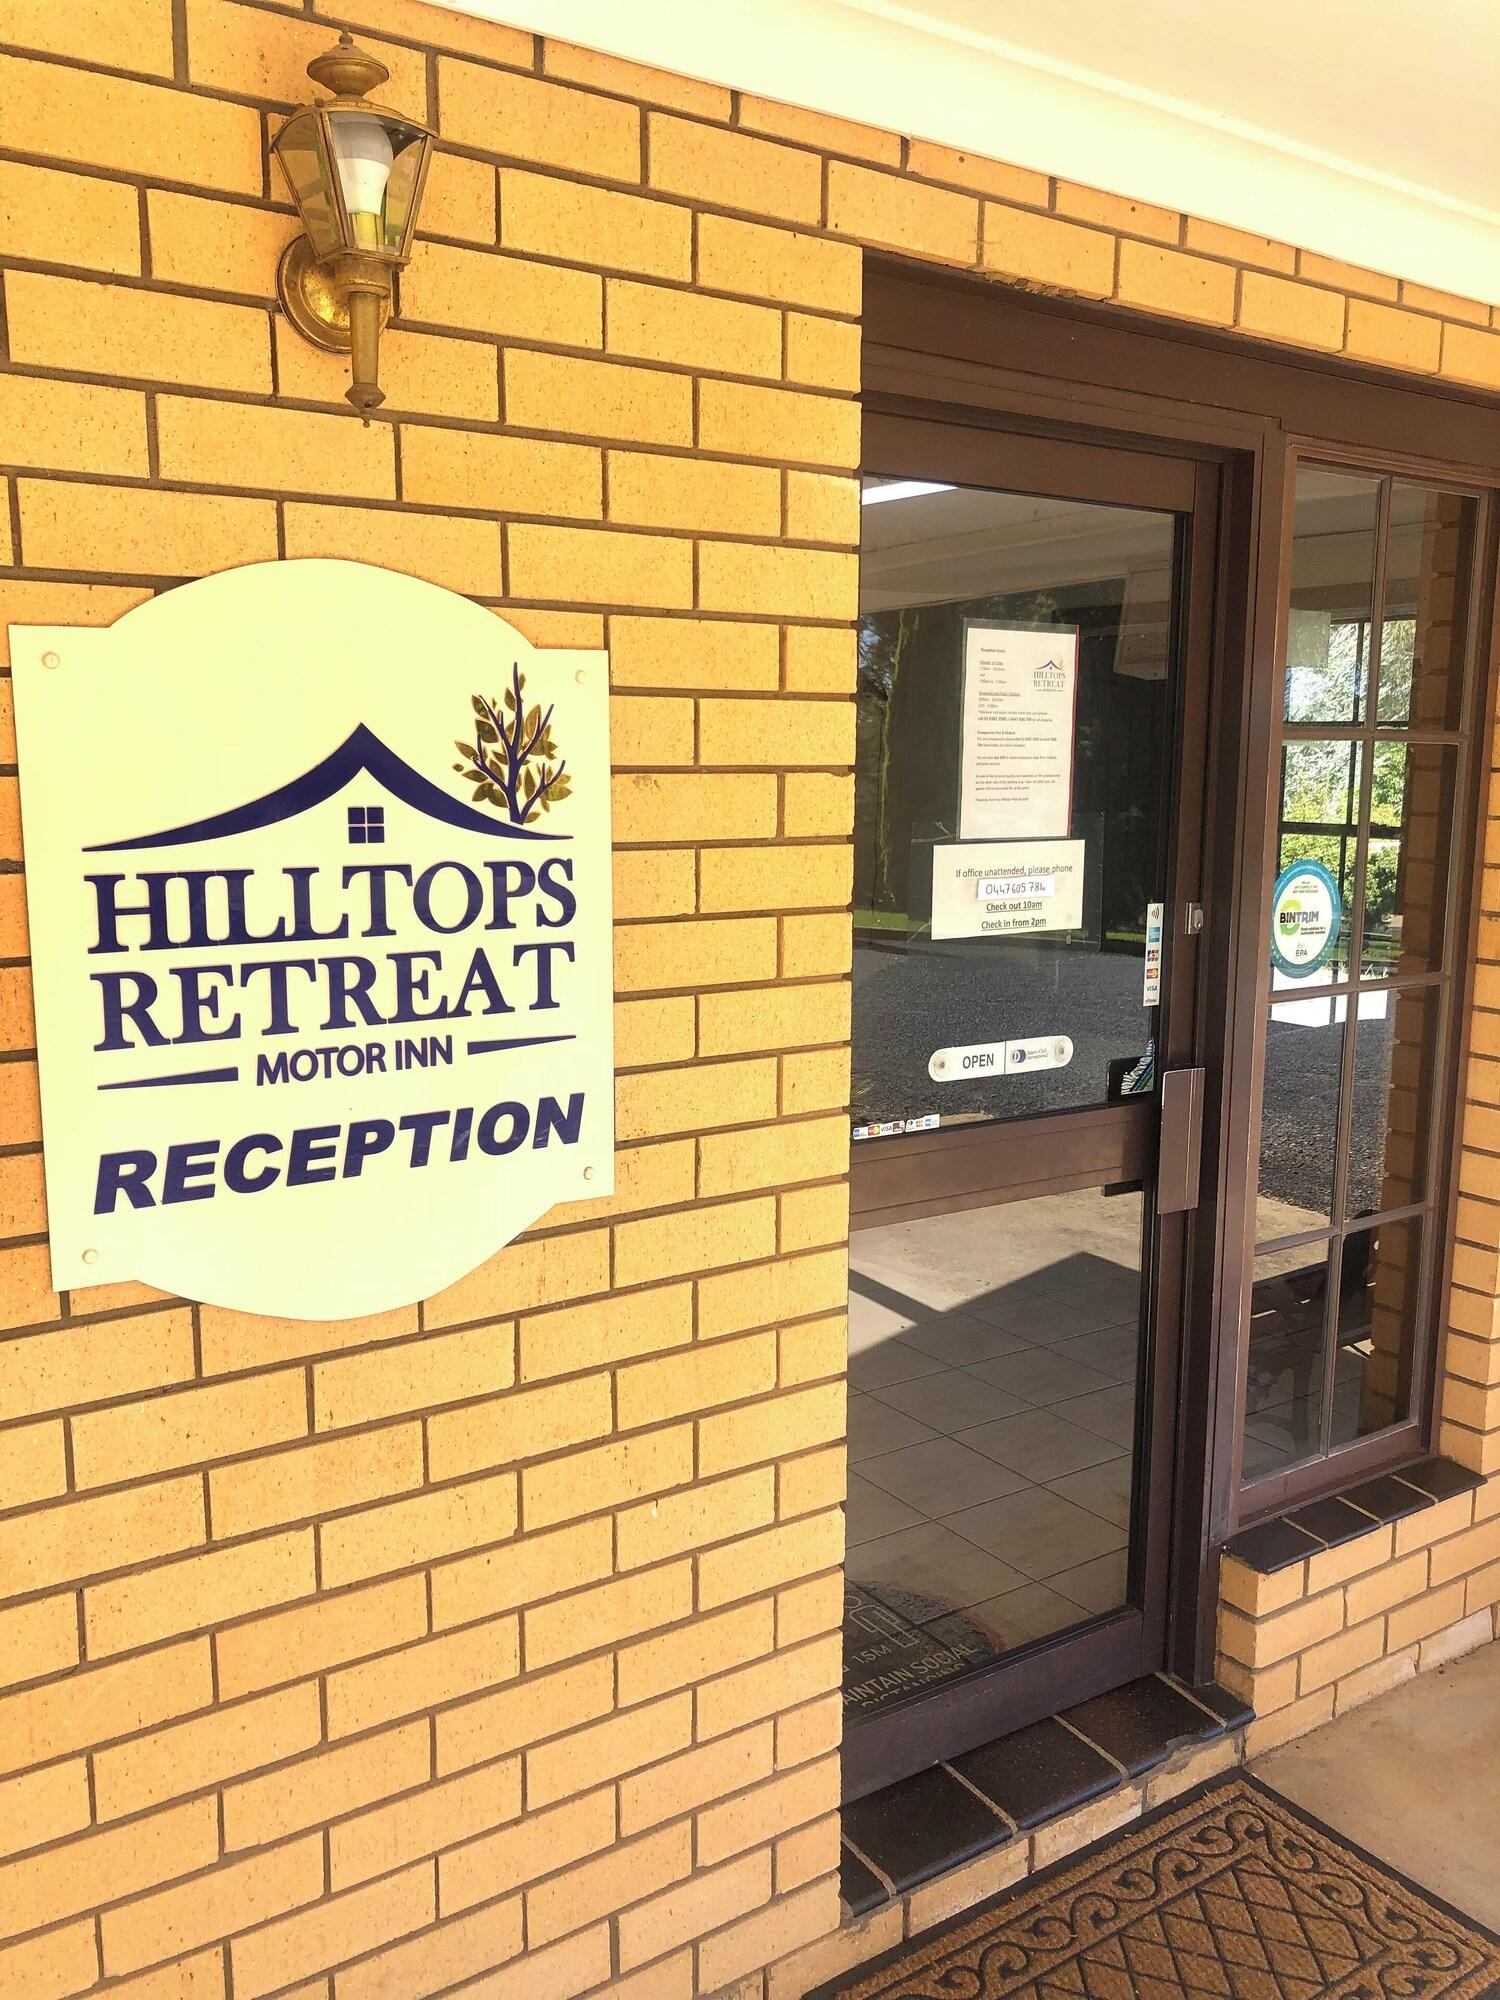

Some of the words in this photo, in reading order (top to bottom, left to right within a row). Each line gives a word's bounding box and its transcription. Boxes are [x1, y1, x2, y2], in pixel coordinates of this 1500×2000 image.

[1033, 671, 1066, 680] HILLTOPS
[1033, 680, 1064, 688] RETREAT
[955, 869, 962, 878] If
[963, 868, 983, 878] office
[985, 866, 1026, 877] unattended,
[1028, 864, 1050, 876] please
[1051, 864, 1073, 875] phone
[84, 857, 577, 955] HILLTOPS
[986, 902, 1007, 912] Check
[1008, 902, 1021, 911] out
[1023, 900, 1042, 909] 10am
[981, 920, 1002, 930] Check
[1003, 918, 1011, 928] in
[1012, 918, 1029, 927] from
[1031, 918, 1046, 928] 2pm
[1295, 949, 1308, 957] EPA
[90, 941, 575, 1052] RETREAT
[256, 1043, 386, 1087] MOTOR
[395, 1035, 454, 1070] INN
[962, 1053, 994, 1069] OPEN
[93, 1092, 586, 1215] RECEPTION
[842, 1667, 915, 1706] AINTAIN
[909, 1643, 980, 1675] SOCIAL
